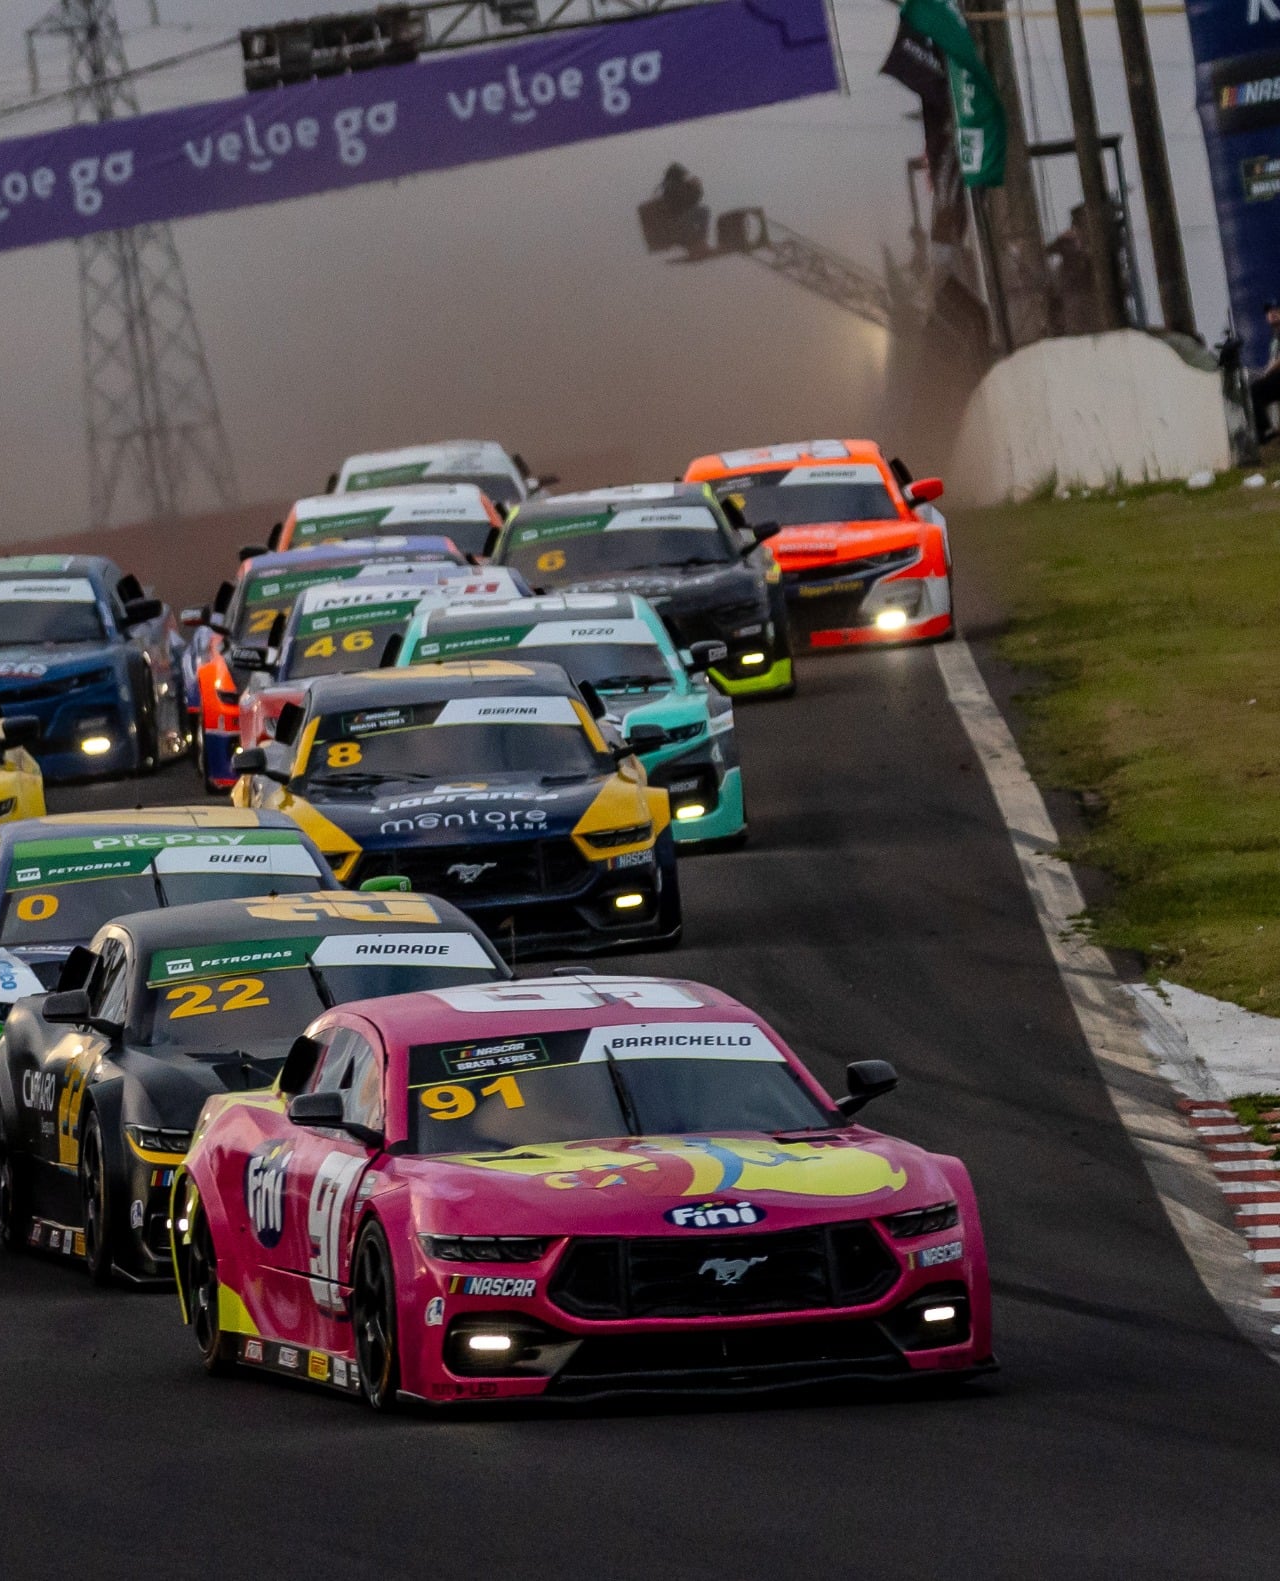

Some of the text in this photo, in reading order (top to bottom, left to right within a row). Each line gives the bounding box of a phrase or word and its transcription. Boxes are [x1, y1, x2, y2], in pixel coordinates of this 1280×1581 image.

[447, 48, 662, 122] veloe go
[185, 99, 399, 172] veloe go
[70, 150, 136, 215] go
[536, 550, 566, 572] 6
[570, 628, 615, 637] TOZZO
[303, 630, 375, 658] 46
[477, 707, 538, 716] IBIAPINA
[327, 741, 363, 768] 8
[380, 809, 547, 834] mentore
[497, 823, 548, 832] BANK
[48, 861, 131, 875] PETROBRAS
[209, 853, 268, 864] BUENO
[16, 893, 59, 922] 0
[200, 950, 293, 967] PETROBRAS
[356, 944, 450, 955] ANDRADE
[165, 978, 270, 1019] 22
[477, 1042, 526, 1057] NASCAR
[611, 1035, 752, 1049] BARRICHELLO
[456, 1051, 537, 1071] BRASIL SERIES
[420, 1075, 526, 1121] 91
[671, 1201, 758, 1227] Fini
[468, 1277, 537, 1297] NASCAR
